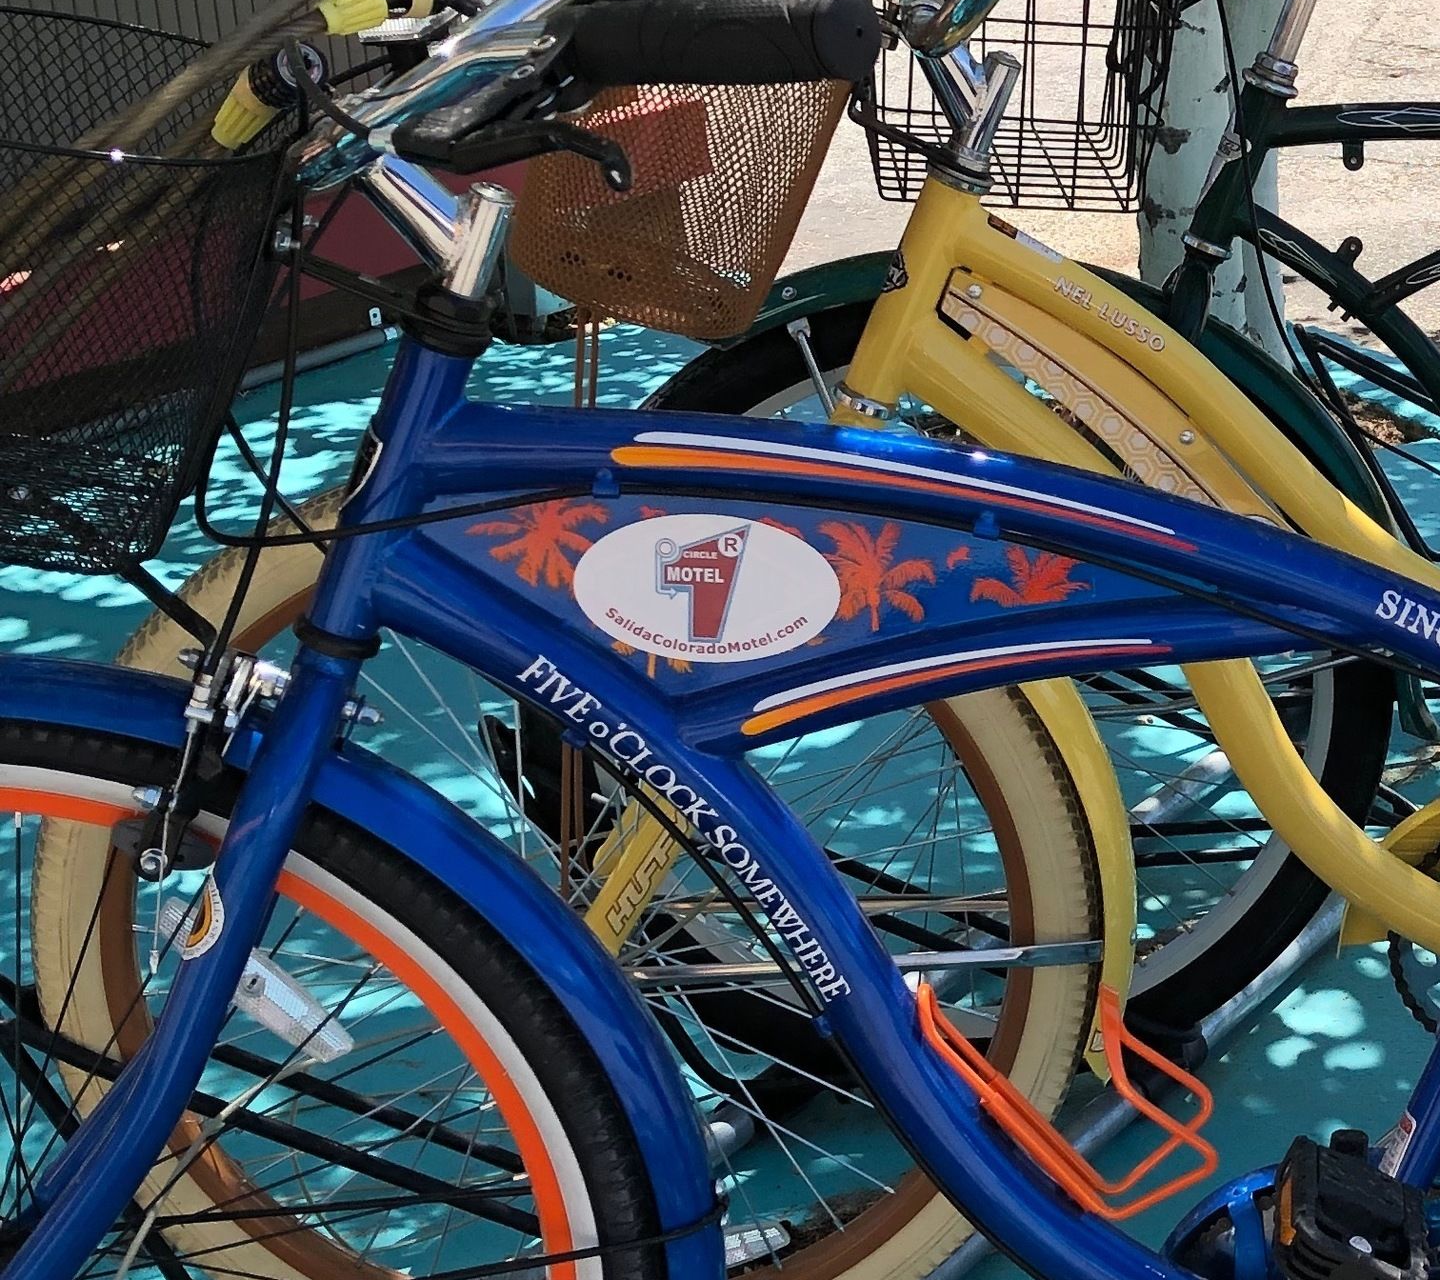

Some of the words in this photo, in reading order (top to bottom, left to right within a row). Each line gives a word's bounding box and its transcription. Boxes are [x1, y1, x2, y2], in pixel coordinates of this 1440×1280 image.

[1054, 275, 1093, 310] NEL
[1099, 303, 1166, 351] LUSSO
[683, 550, 718, 560] CIRCLE
[724, 536, 738, 552] R
[667, 566, 724, 584] MOTEL
[605, 607, 808, 654] SalidaColoradoMotel.com
[516, 655, 602, 723] FIVE
[704, 825, 851, 1003] SOMEWHERE
